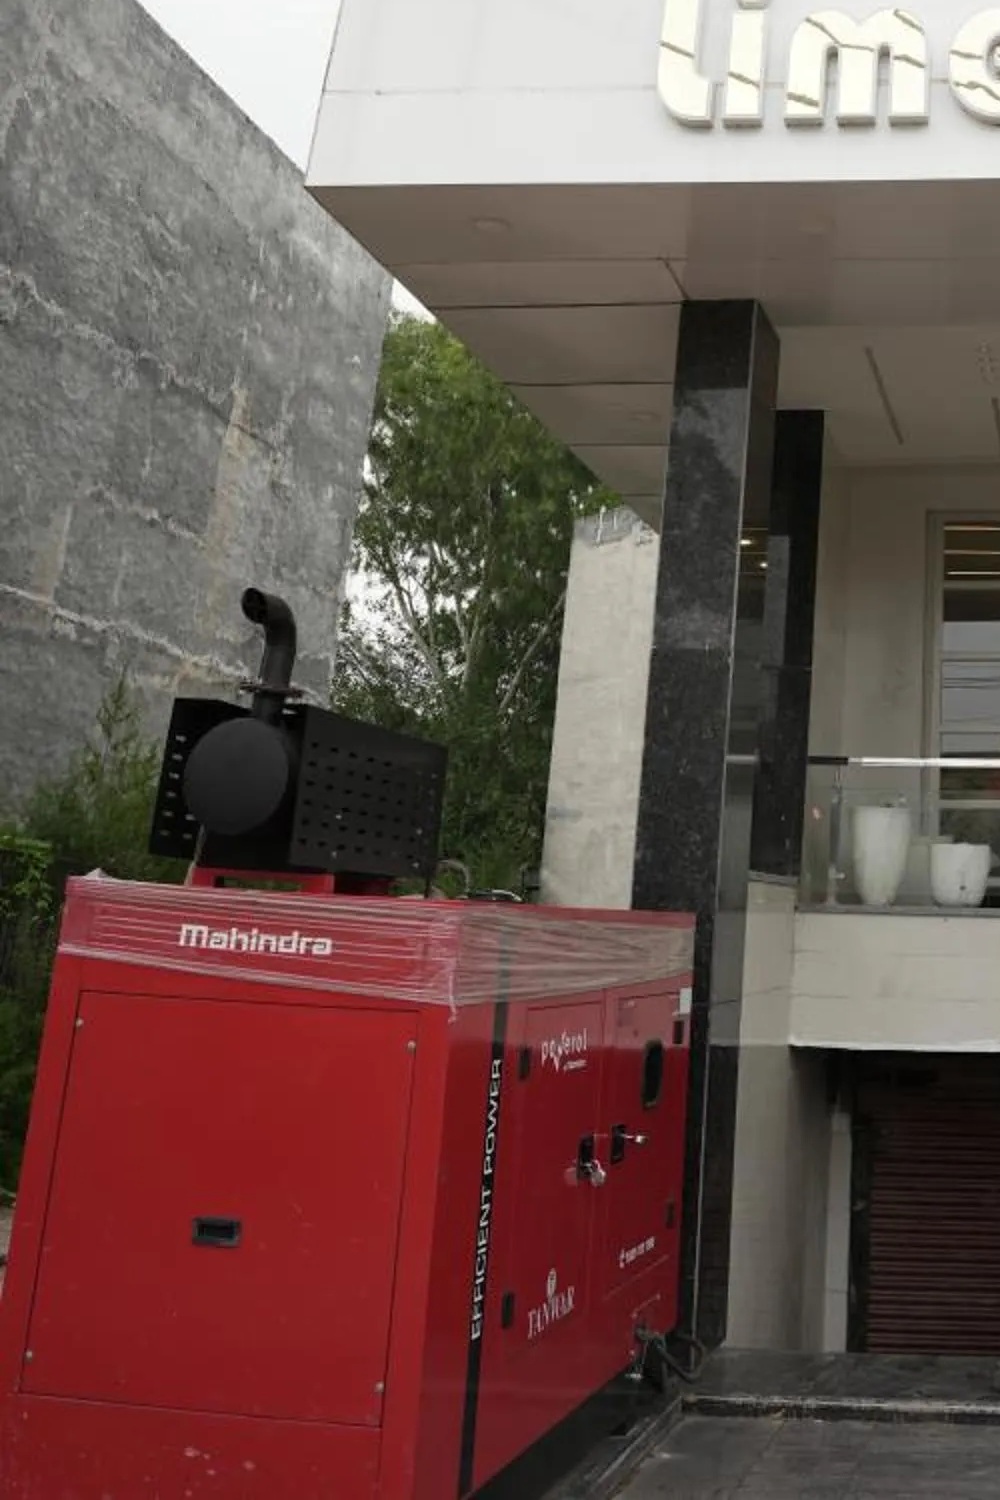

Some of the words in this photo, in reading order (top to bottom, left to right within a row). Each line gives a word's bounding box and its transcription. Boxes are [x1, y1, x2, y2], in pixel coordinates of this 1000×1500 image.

[179, 923, 333, 955] Mahindra
[471, 1186, 491, 1341] EFFICIENT
[483, 1059, 502, 1176] POWER
